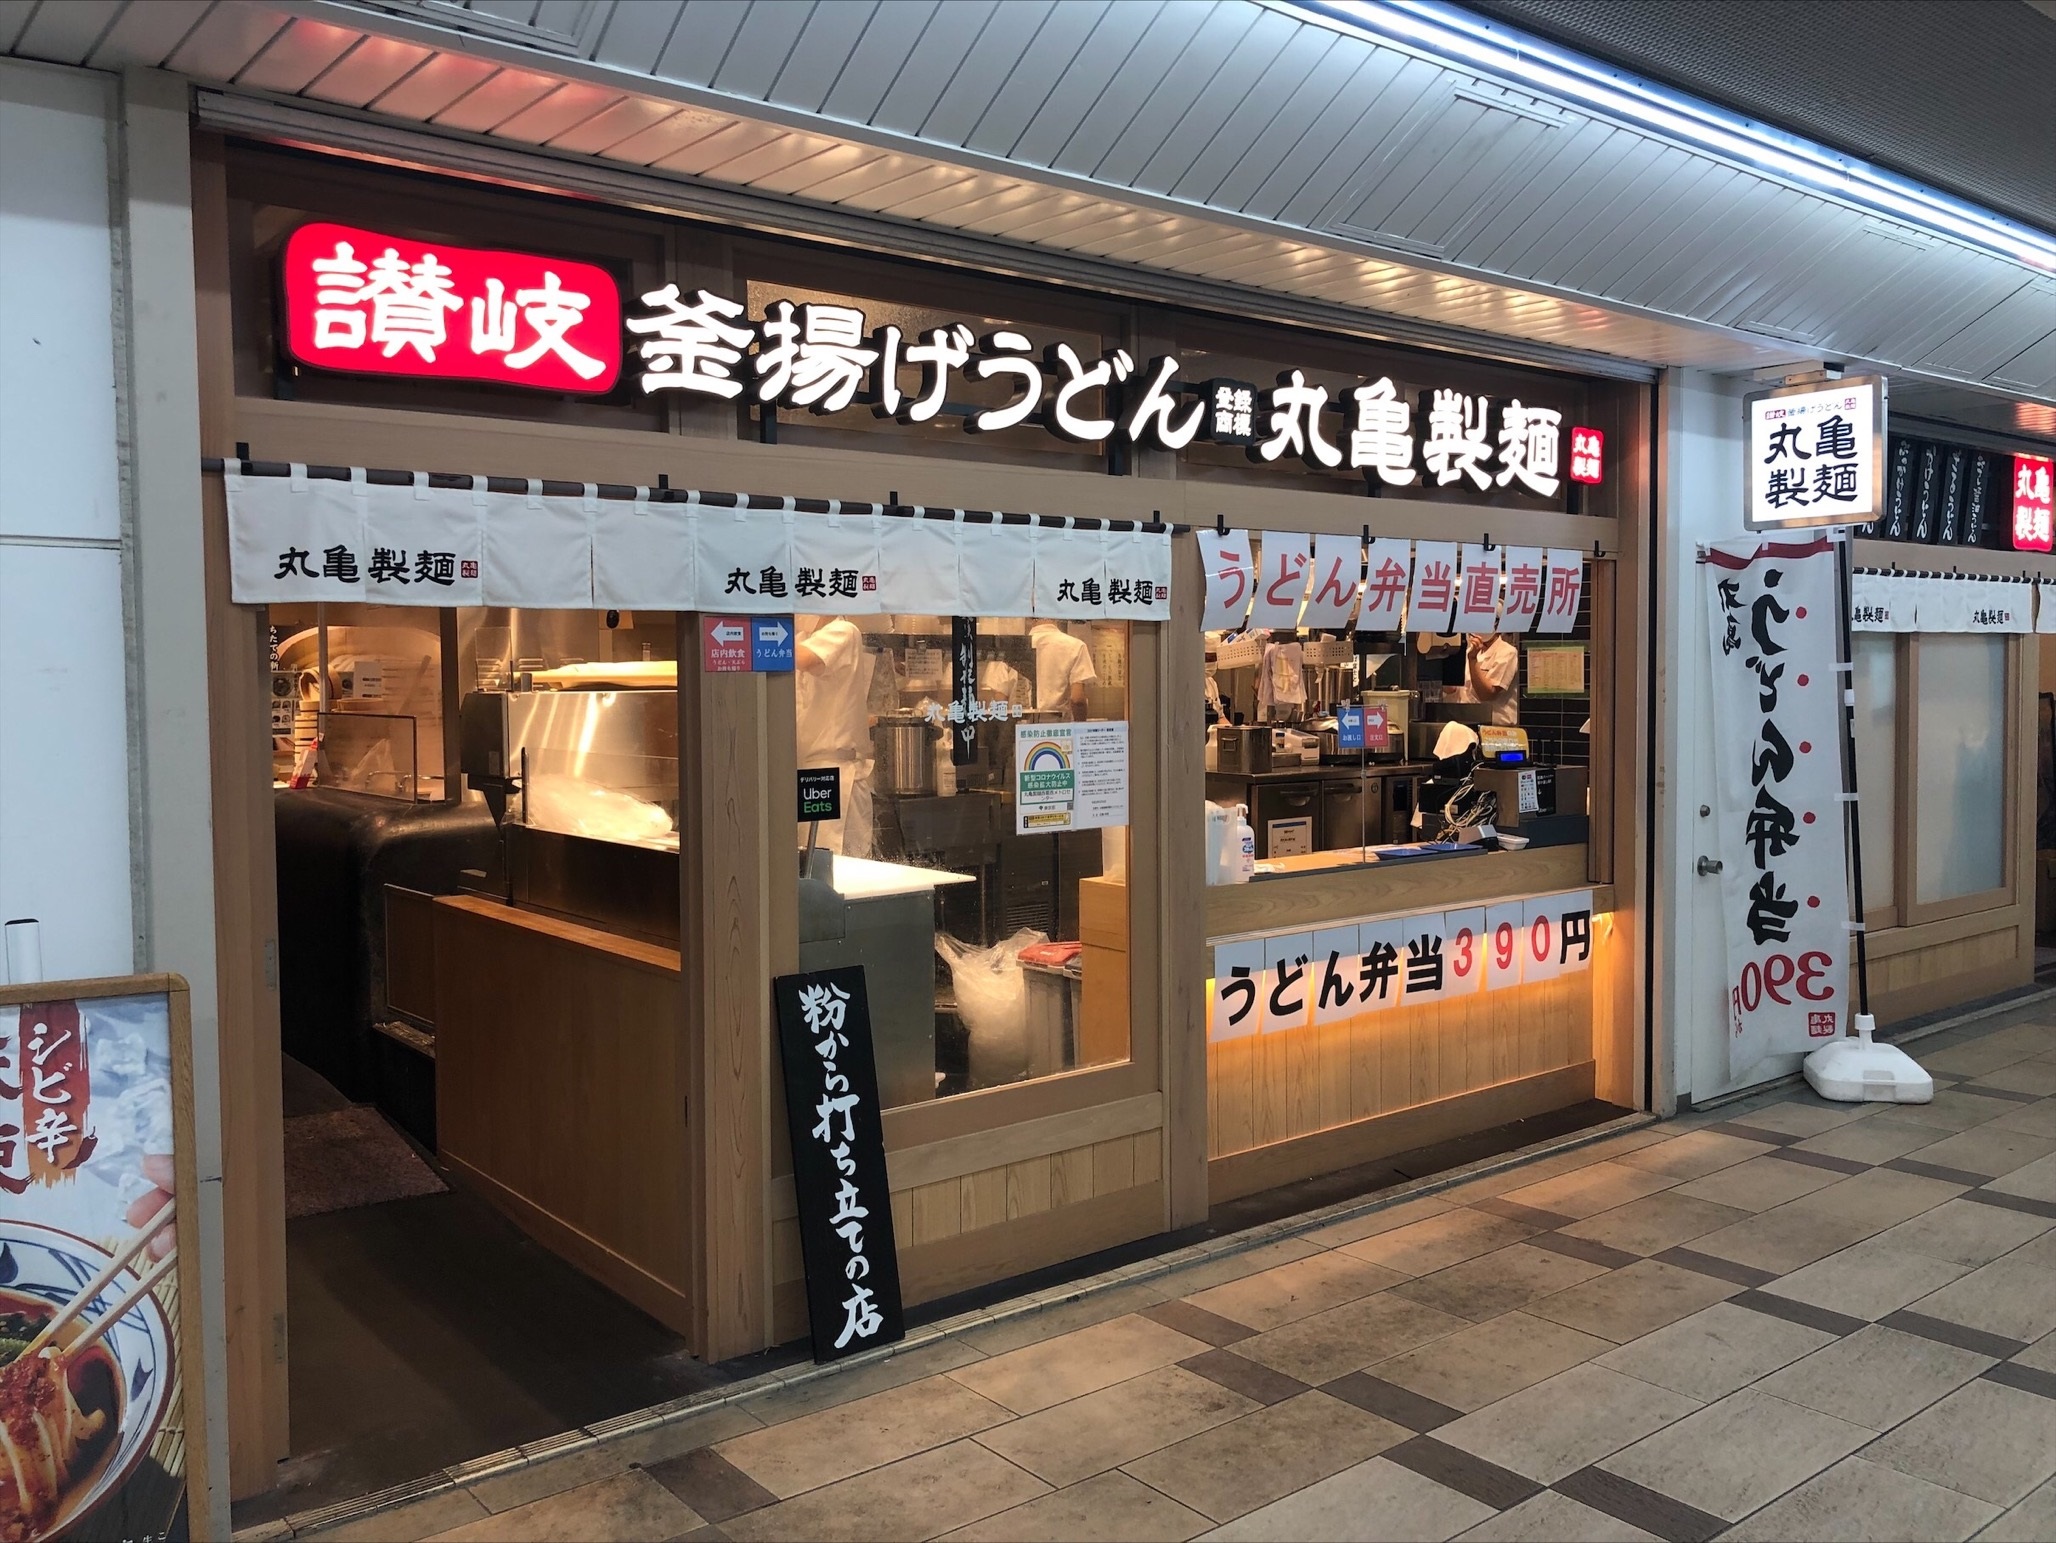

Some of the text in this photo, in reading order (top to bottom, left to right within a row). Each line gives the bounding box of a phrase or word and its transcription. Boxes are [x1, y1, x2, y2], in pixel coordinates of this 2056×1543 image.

[312, 241, 606, 379] 讃岐
[625, 283, 1205, 450] 釜揚げうどん
[1260, 369, 1563, 497] 丸亀製麺
[1764, 415, 1858, 464] 丸亀
[1765, 463, 1859, 509] 製麺
[2015, 463, 2051, 504] 丸亀
[274, 544, 456, 586] 丸亀製麺
[724, 565, 859, 598] 丸亀製麺
[1217, 550, 1580, 617] うどん弁当直売所
[1057, 577, 1153, 605] 丸亀製麺
[1851, 606, 1884, 623] 亀製麺
[711, 648, 745, 658] 店内飲食
[756, 648, 793, 658] うどん弁当
[924, 699, 1009, 724] 丸亀製麺
[803, 787, 832, 800] Uber
[803, 801, 833, 813] Eats
[1220, 909, 1592, 1026] うどん弁当390円
[25, 1022, 78, 1164] シビ辛
[798, 981, 884, 1350] 粉から打ち立ての店
